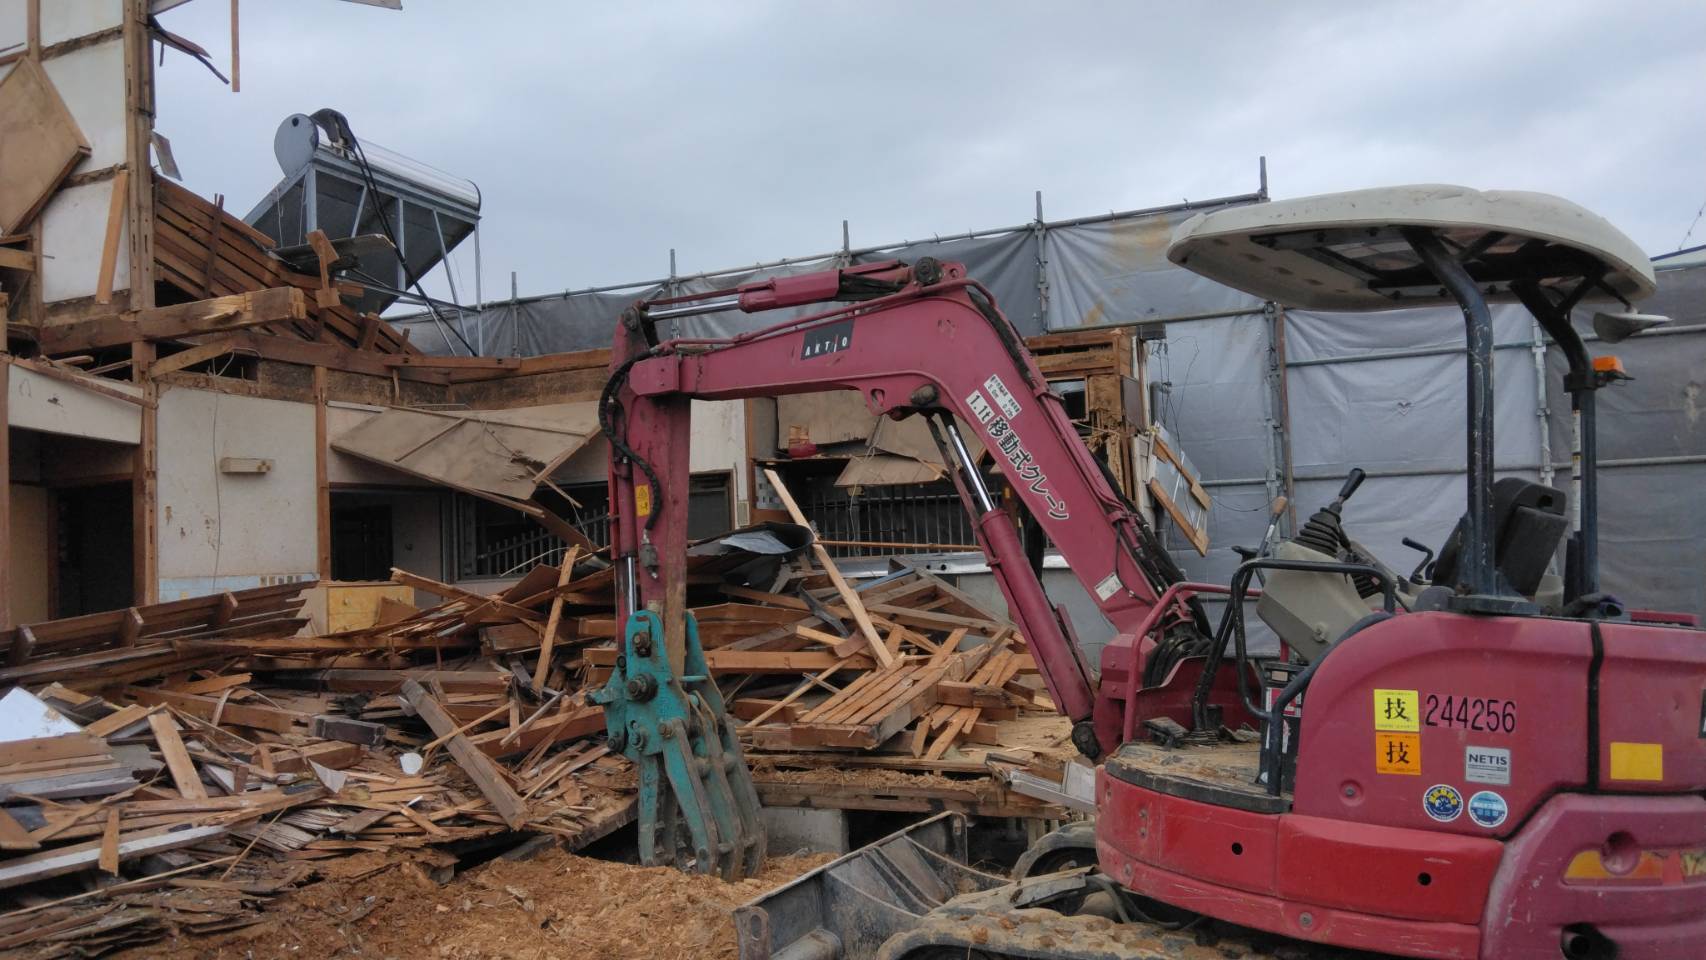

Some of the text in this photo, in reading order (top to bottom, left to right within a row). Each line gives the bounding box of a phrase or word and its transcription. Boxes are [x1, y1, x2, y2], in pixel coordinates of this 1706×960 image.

[805, 334, 848, 356] AKTIO
[969, 394, 1068, 519] 1.1t 移動式クレーン
[1384, 697, 1408, 720] 技
[1425, 695, 1515, 733] 244256
[1386, 741, 1410, 764] 技
[1468, 754, 1508, 765] NETIS
